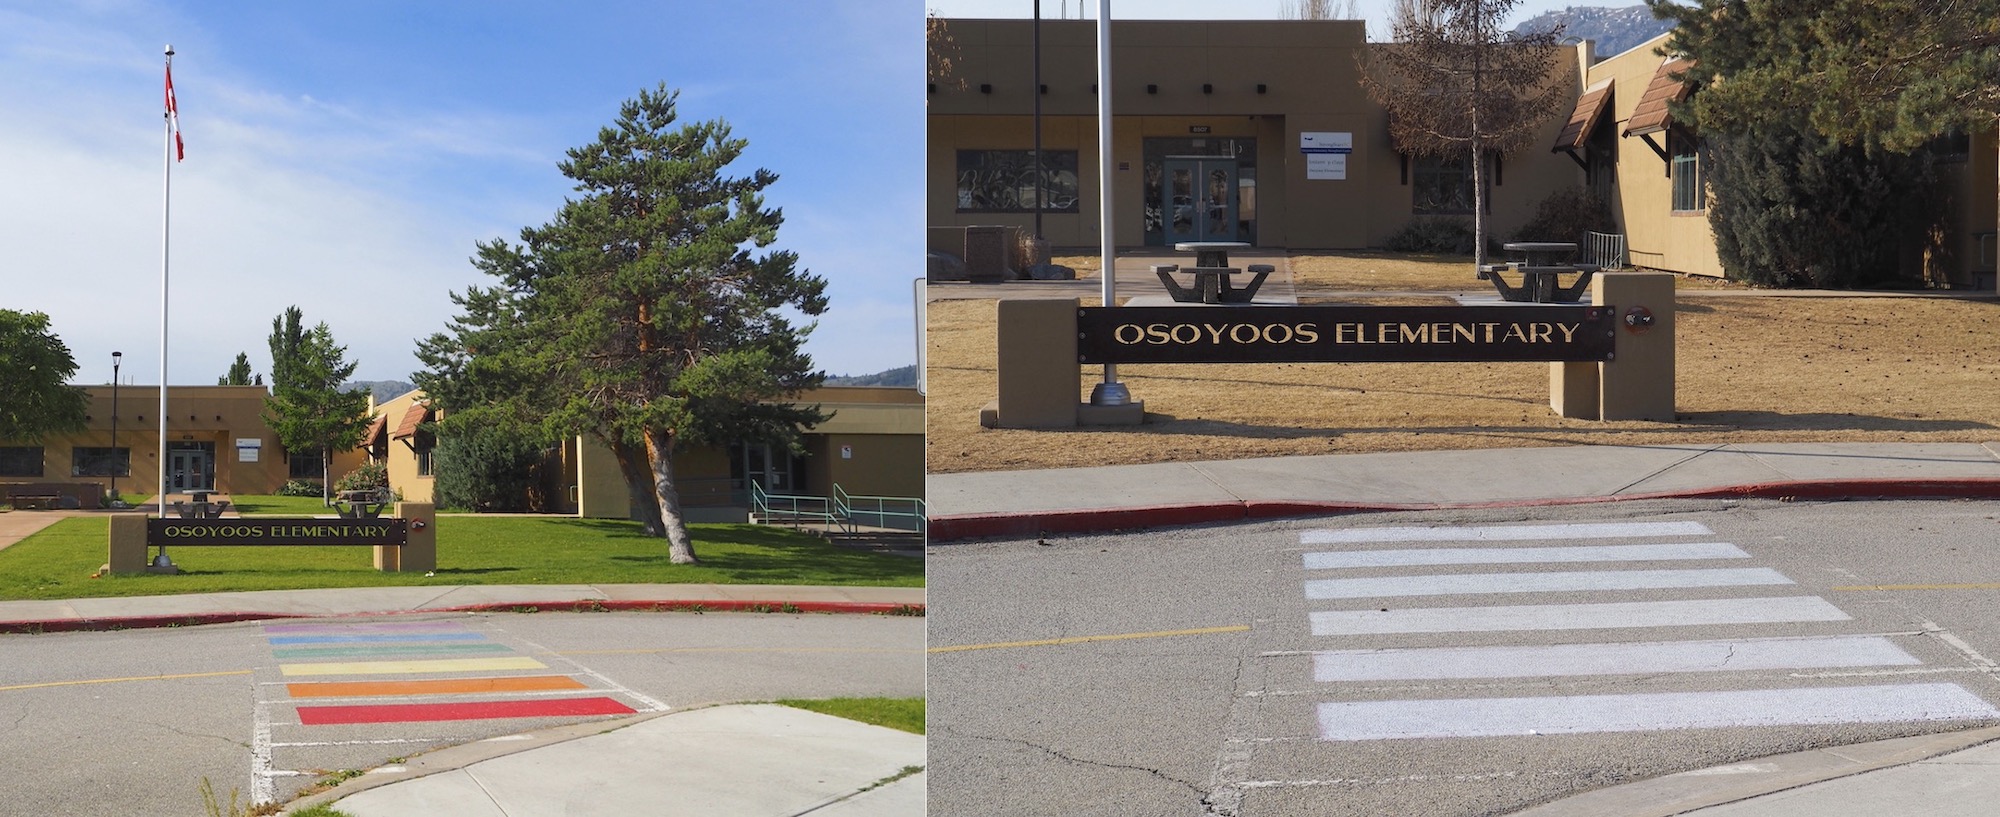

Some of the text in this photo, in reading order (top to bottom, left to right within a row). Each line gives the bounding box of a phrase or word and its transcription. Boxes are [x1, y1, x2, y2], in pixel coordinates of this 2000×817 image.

[1114, 322, 1580, 345] OSOYOOS ELEMENTARY
[164, 525, 390, 538] OSOYOOS ELEMENTARY
